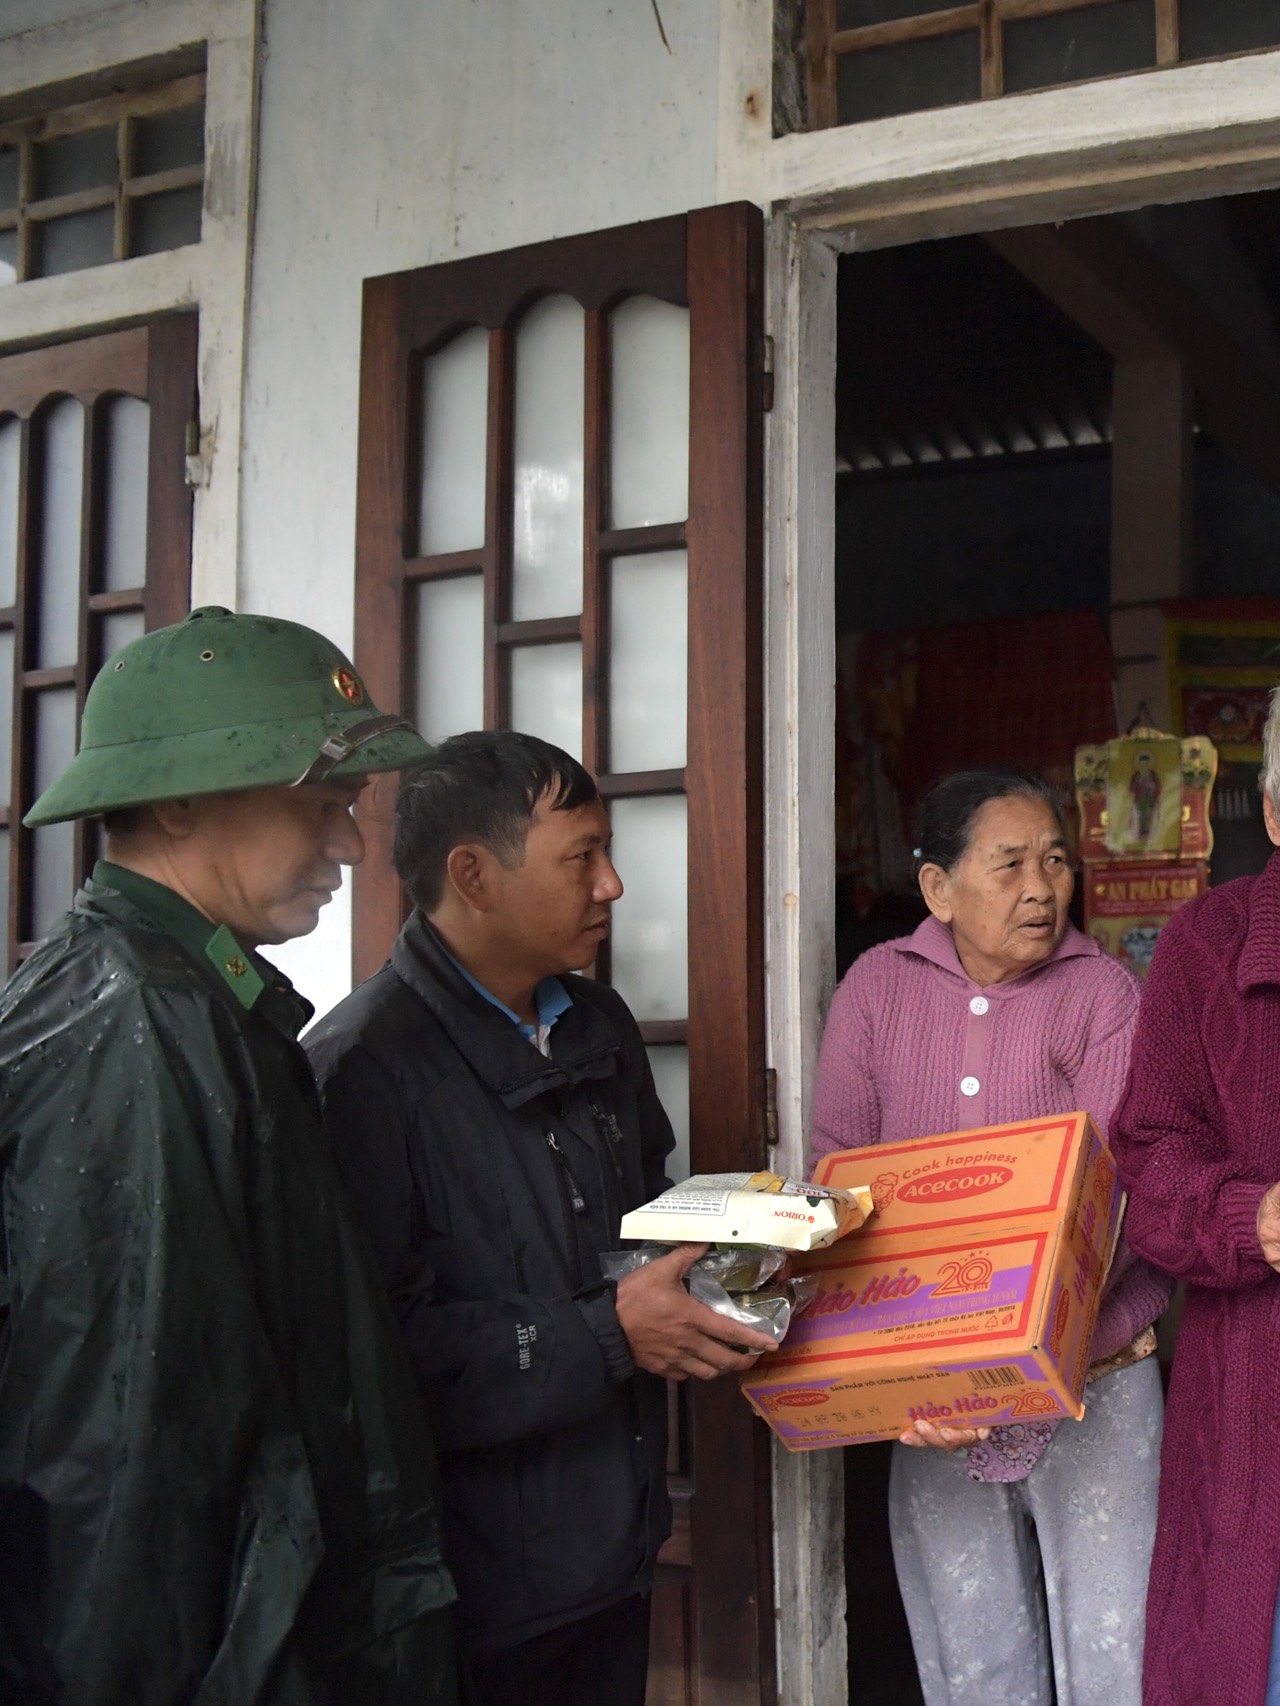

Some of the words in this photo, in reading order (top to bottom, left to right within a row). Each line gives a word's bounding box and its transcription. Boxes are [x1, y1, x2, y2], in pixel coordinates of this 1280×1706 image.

[902, 1159, 941, 1180] Cook
[945, 1151, 1019, 1167] happiness
[774, 1211, 806, 1221] ORION
[859, 1267, 921, 1306] Hảo
[930, 1257, 993, 1297] 20
[529, 1324, 537, 1342] XCR
[953, 1392, 998, 1413] Hảo
